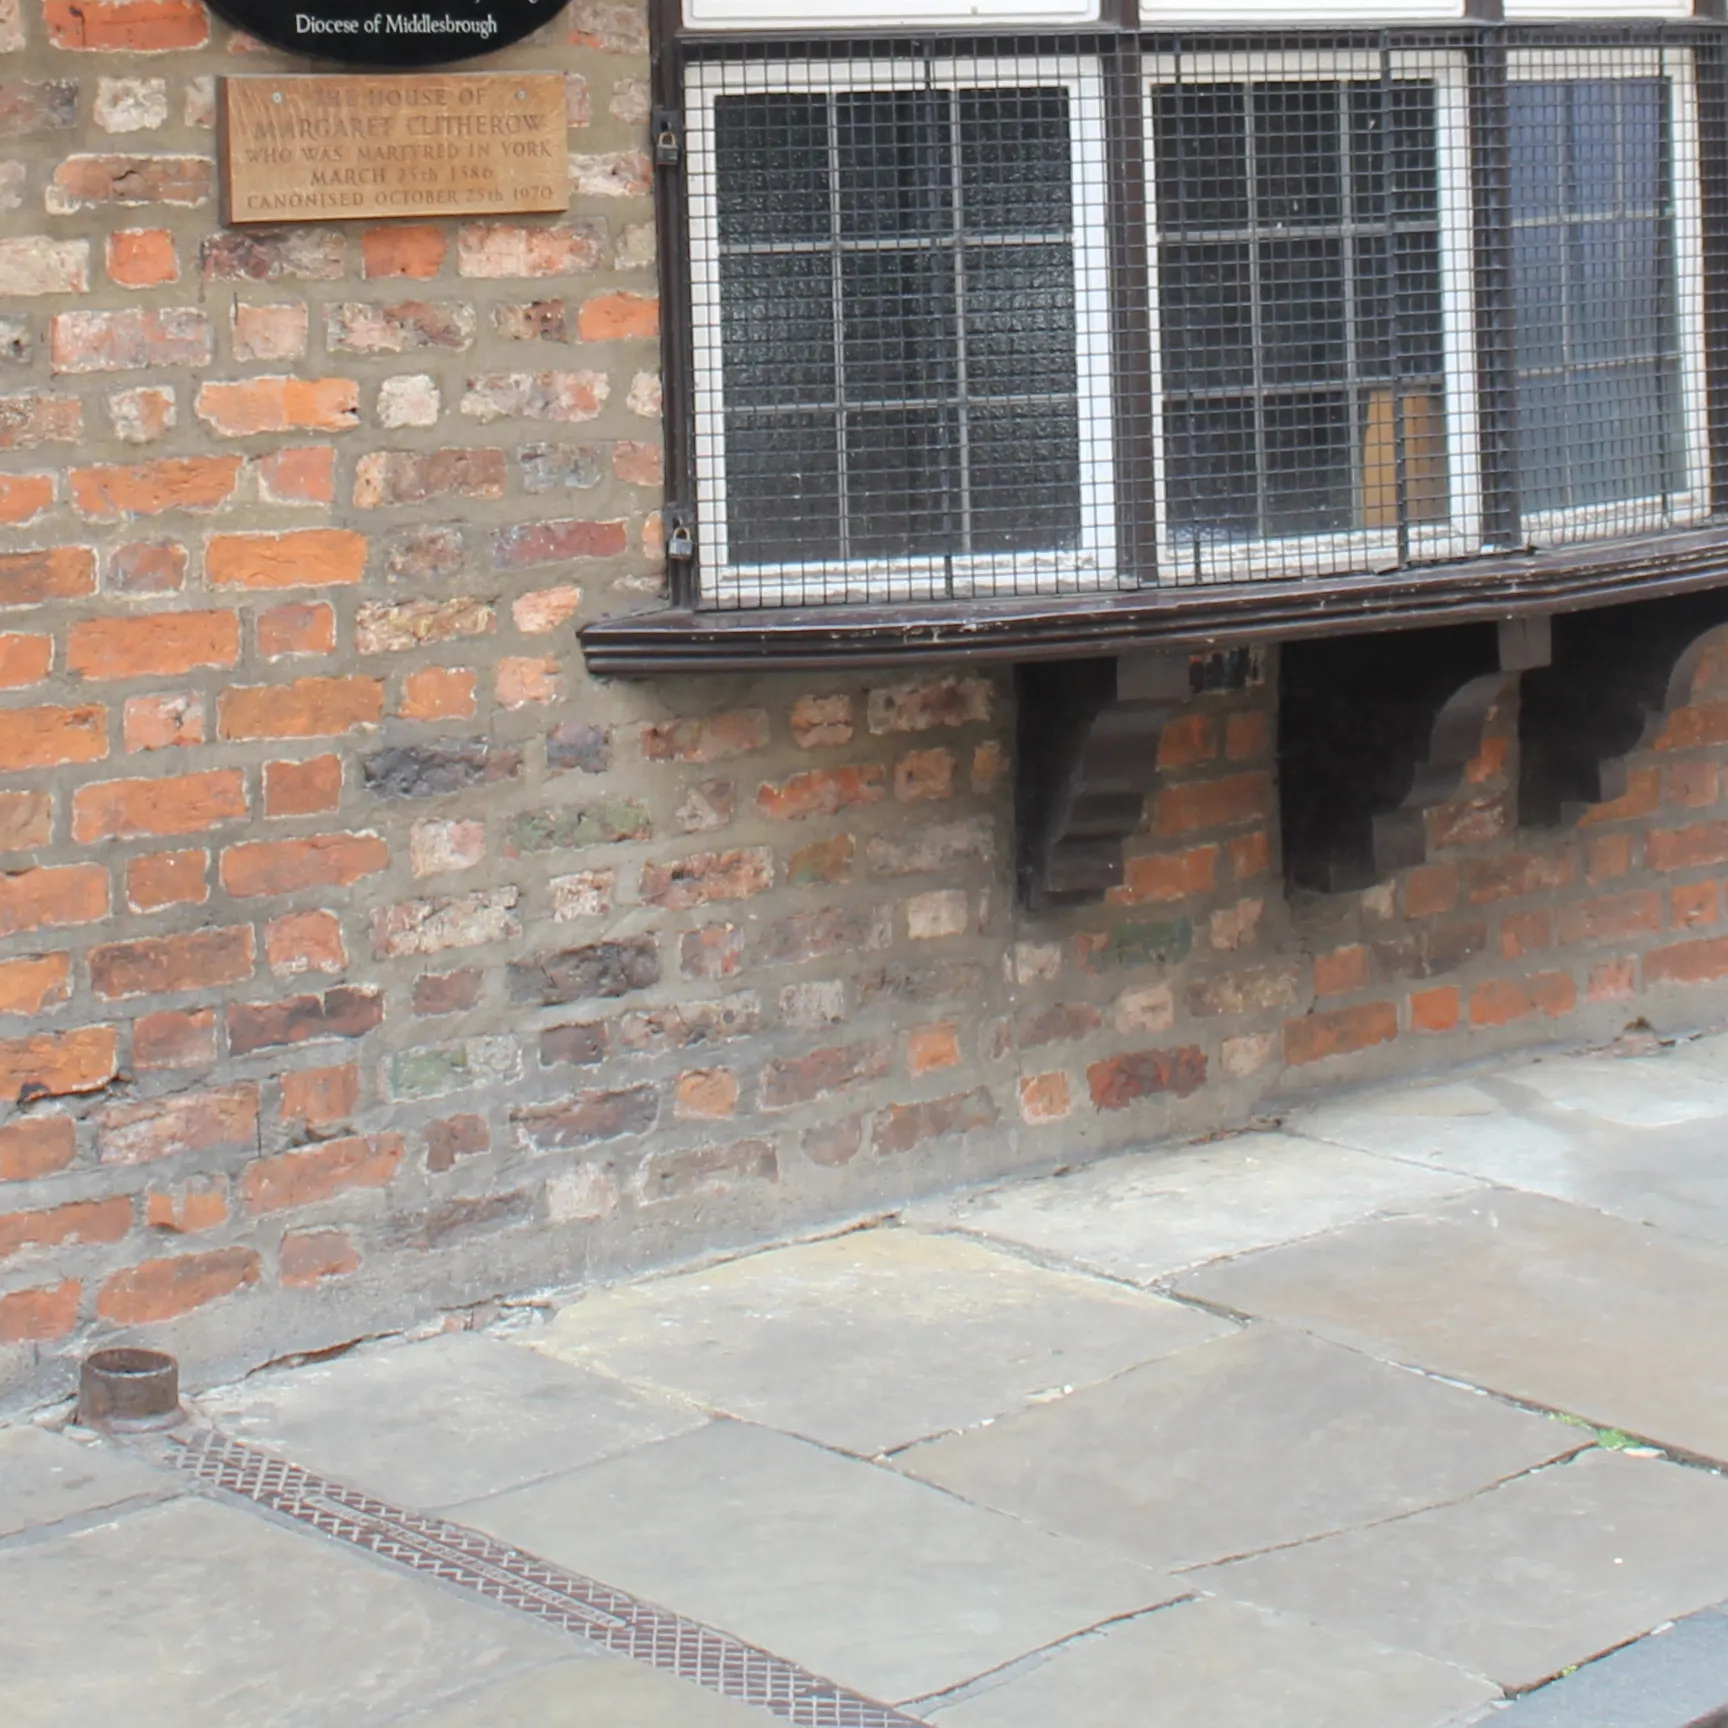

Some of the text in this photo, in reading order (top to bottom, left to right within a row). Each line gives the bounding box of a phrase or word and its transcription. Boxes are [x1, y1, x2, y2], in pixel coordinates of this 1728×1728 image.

[295, 13, 498, 39] Diocese of Middlesbrough
[369, 89, 447, 107] HOUSE
[458, 88, 487, 104] OF
[254, 114, 543, 140] MARGARET CLITHEROW
[246, 141, 553, 164] WHO WAS MARTYRED IN YORK
[311, 168, 386, 186] MARCH
[247, 192, 364, 210] CANONISED
[374, 189, 459, 206] OCTOBER
[465, 189, 503, 203] 25th
